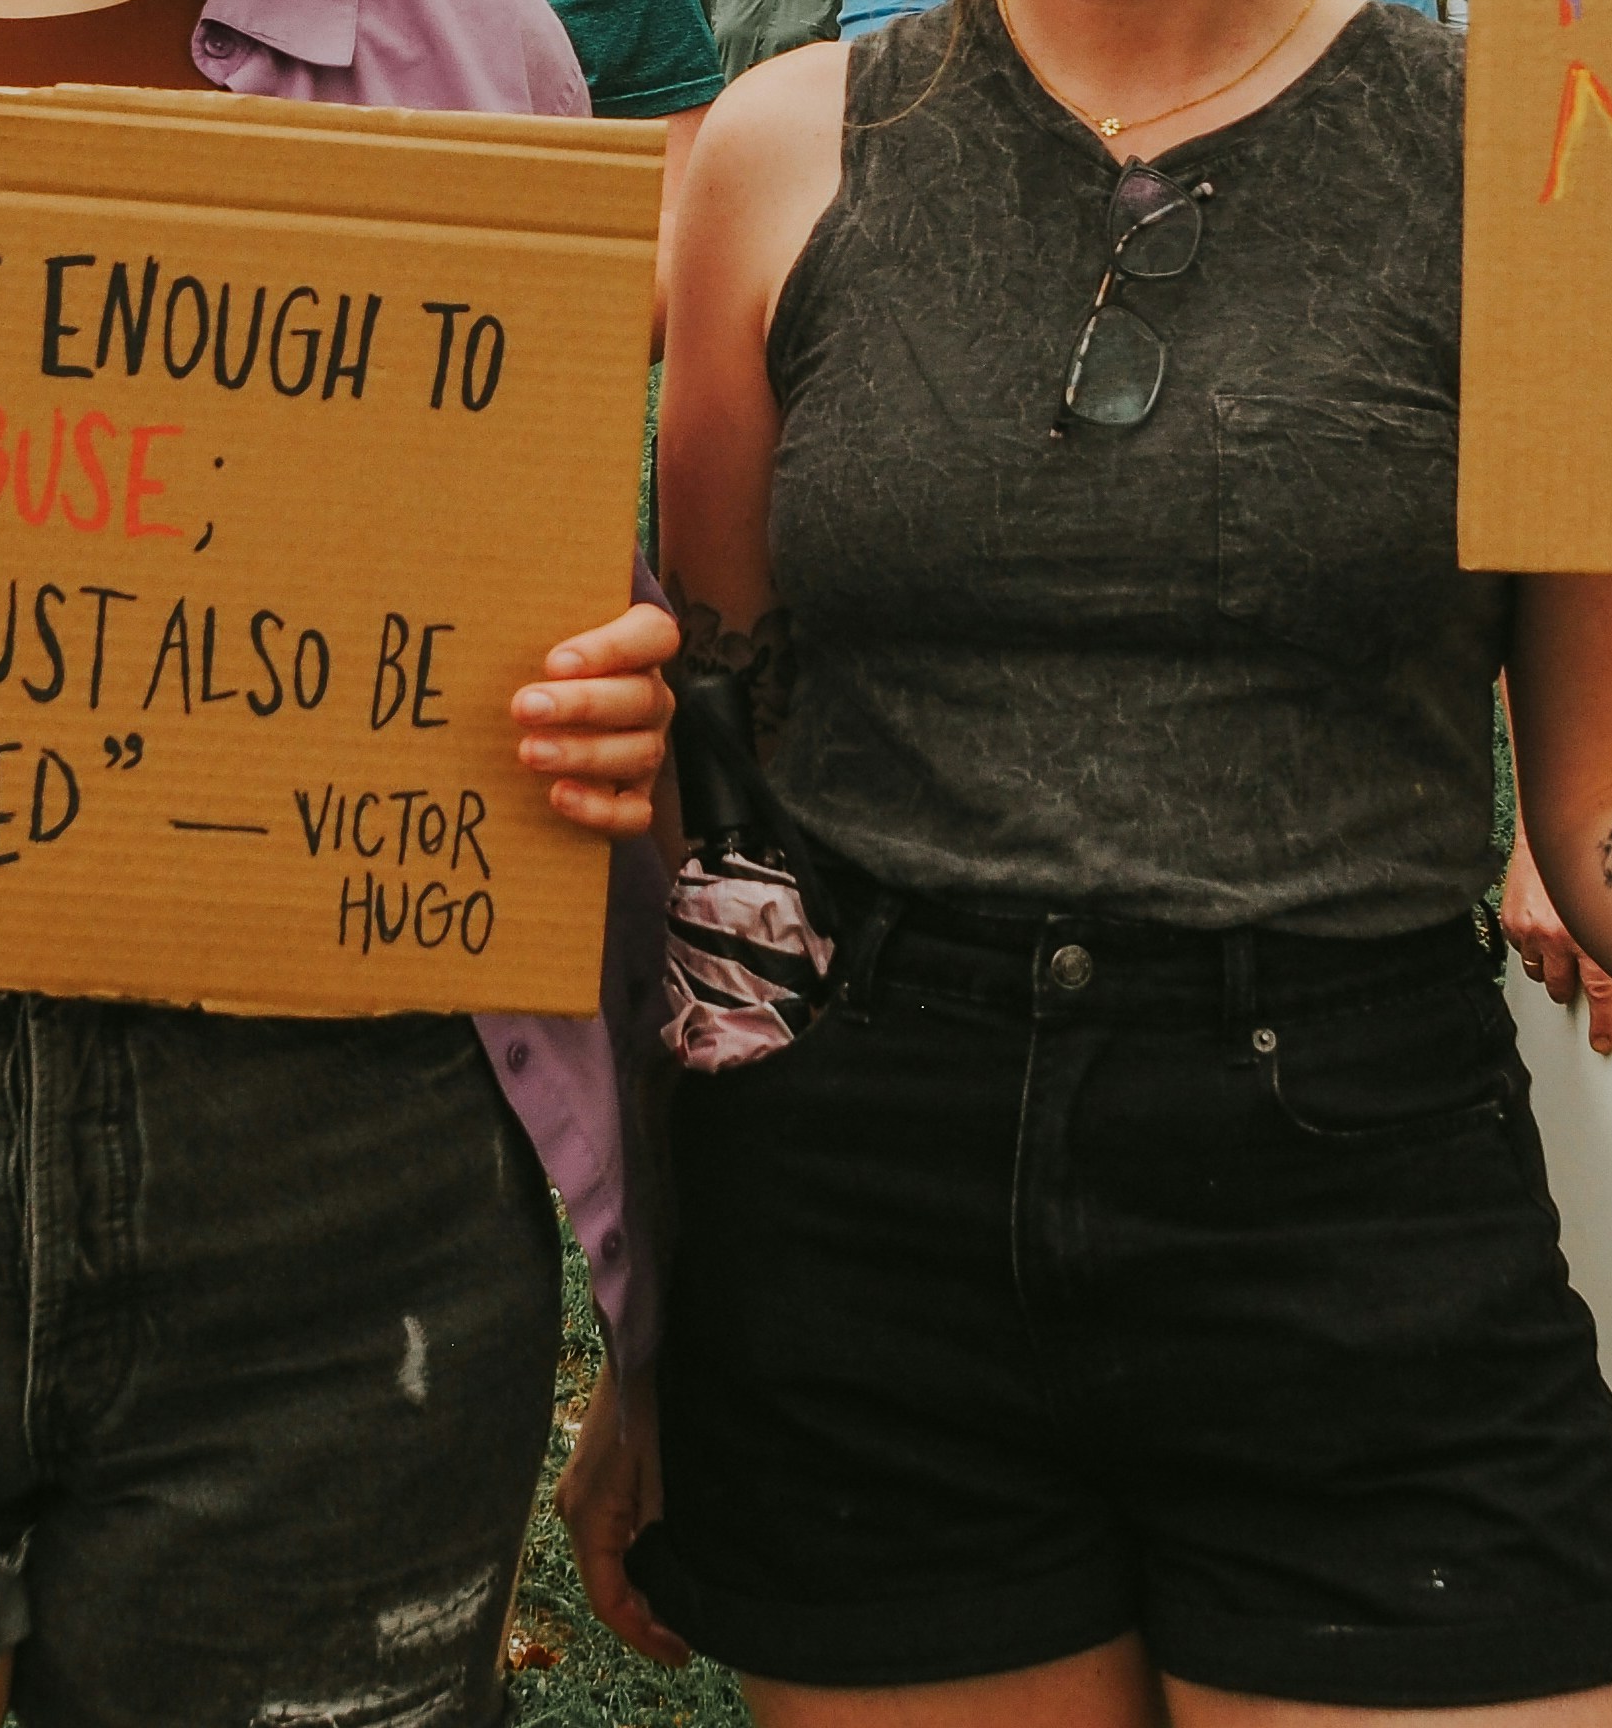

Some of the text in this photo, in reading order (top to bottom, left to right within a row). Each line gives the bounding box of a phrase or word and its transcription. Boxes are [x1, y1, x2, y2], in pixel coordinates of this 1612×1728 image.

[40, 254, 383, 401] ENOUGH
[421, 302, 506, 411] TO
[143, 595, 331, 716] ALSO
[370, 612, 455, 730] BE
[294, 783, 490, 880] VICTOR
[338, 872, 495, 955] HUGO
